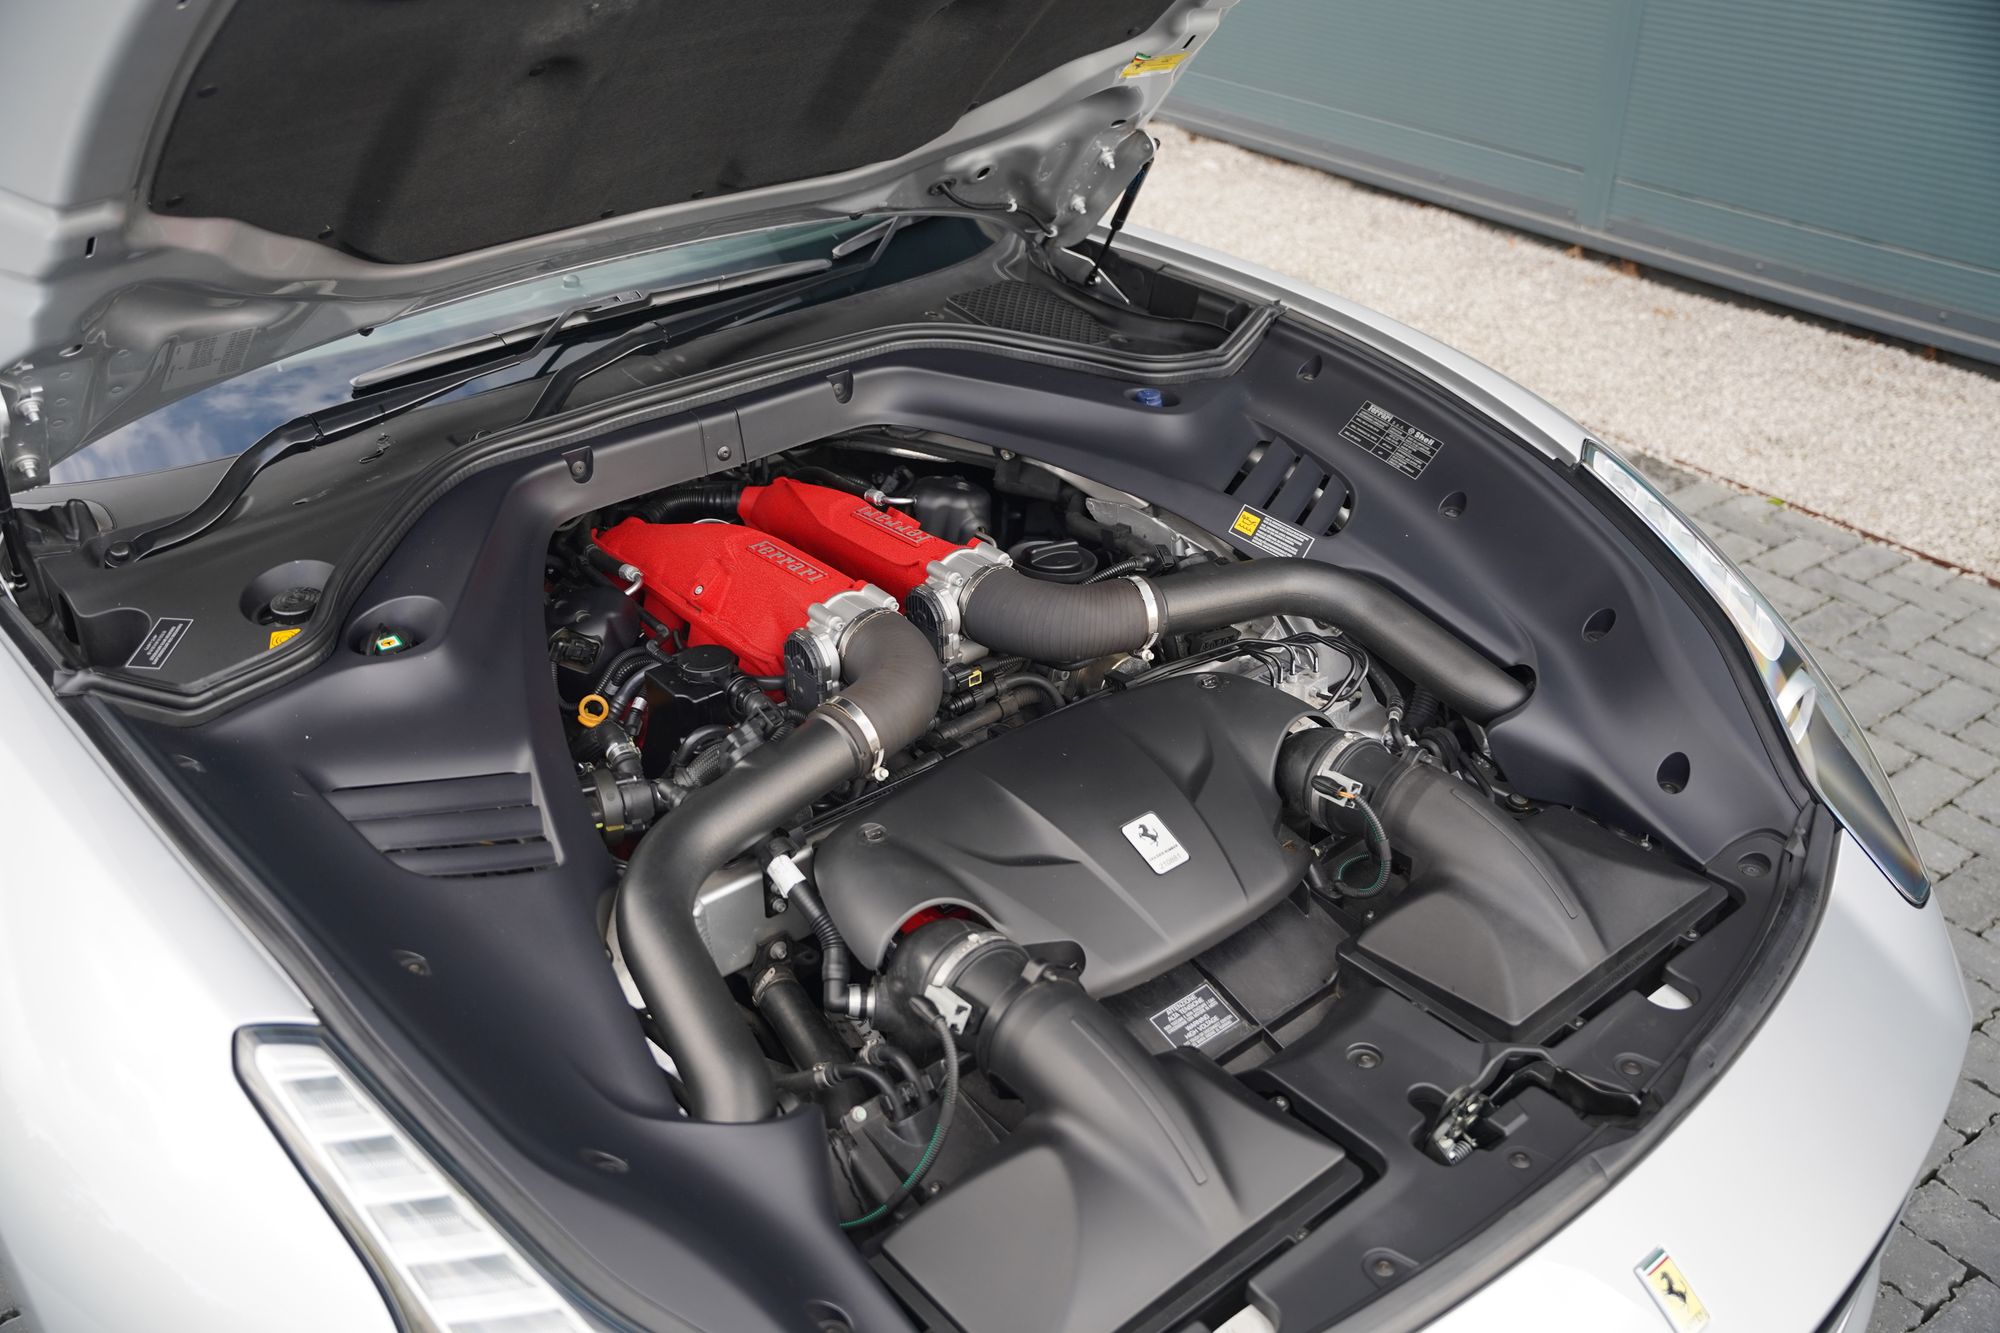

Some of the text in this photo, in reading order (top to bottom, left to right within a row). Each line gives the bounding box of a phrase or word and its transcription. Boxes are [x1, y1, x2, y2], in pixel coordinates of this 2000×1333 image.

[1414, 431, 1435, 446] Shell
[852, 505, 935, 546] Ferrari
[748, 540, 829, 582] Ferrari
[1166, 993, 1198, 1016] ATTENZIONE
[1168, 996, 1205, 1023] ALTA TENSIONE
[1184, 1013, 1210, 1031] WARNING
[1184, 1028, 1200, 1040] HIGH
[1197, 1015, 1220, 1032] VOLTAGE
